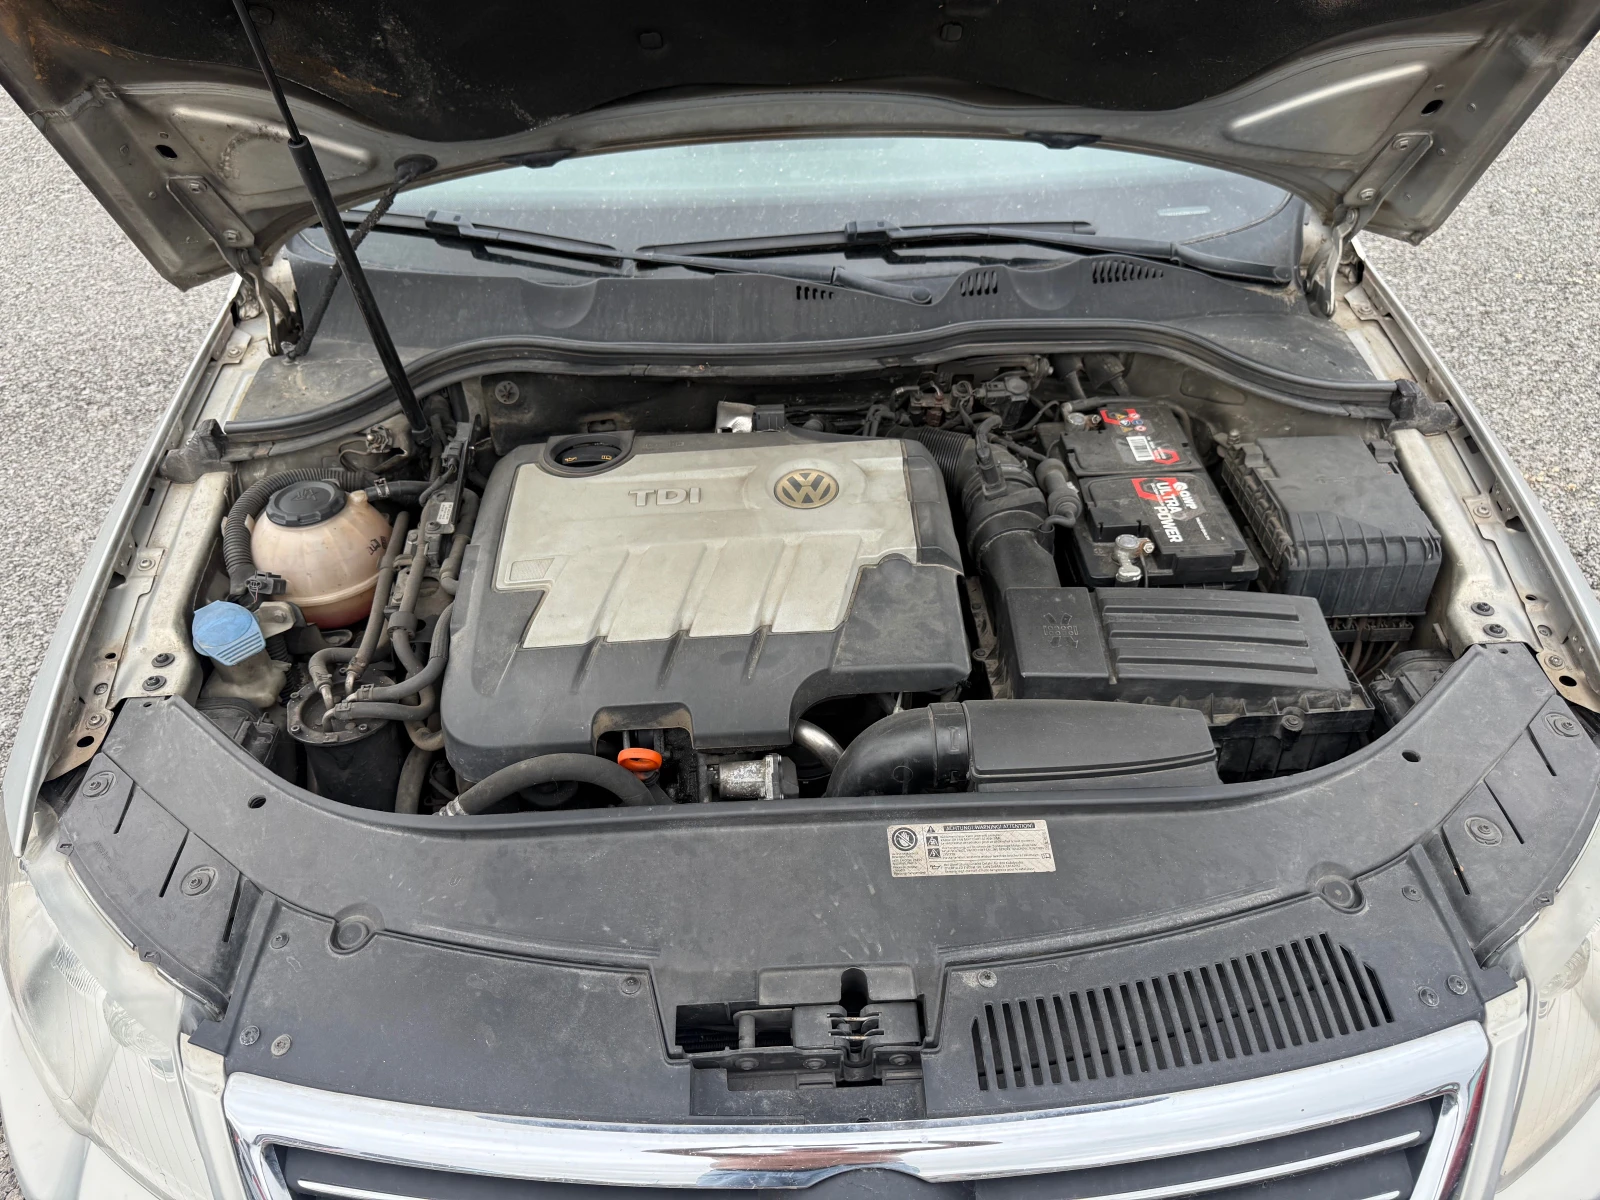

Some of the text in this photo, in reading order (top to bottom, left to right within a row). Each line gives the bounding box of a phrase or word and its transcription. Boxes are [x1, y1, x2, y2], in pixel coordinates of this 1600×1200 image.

[628, 487, 701, 507] TDI
[1156, 482, 1182, 513] ULTRA
[1154, 506, 1183, 542] POWER
